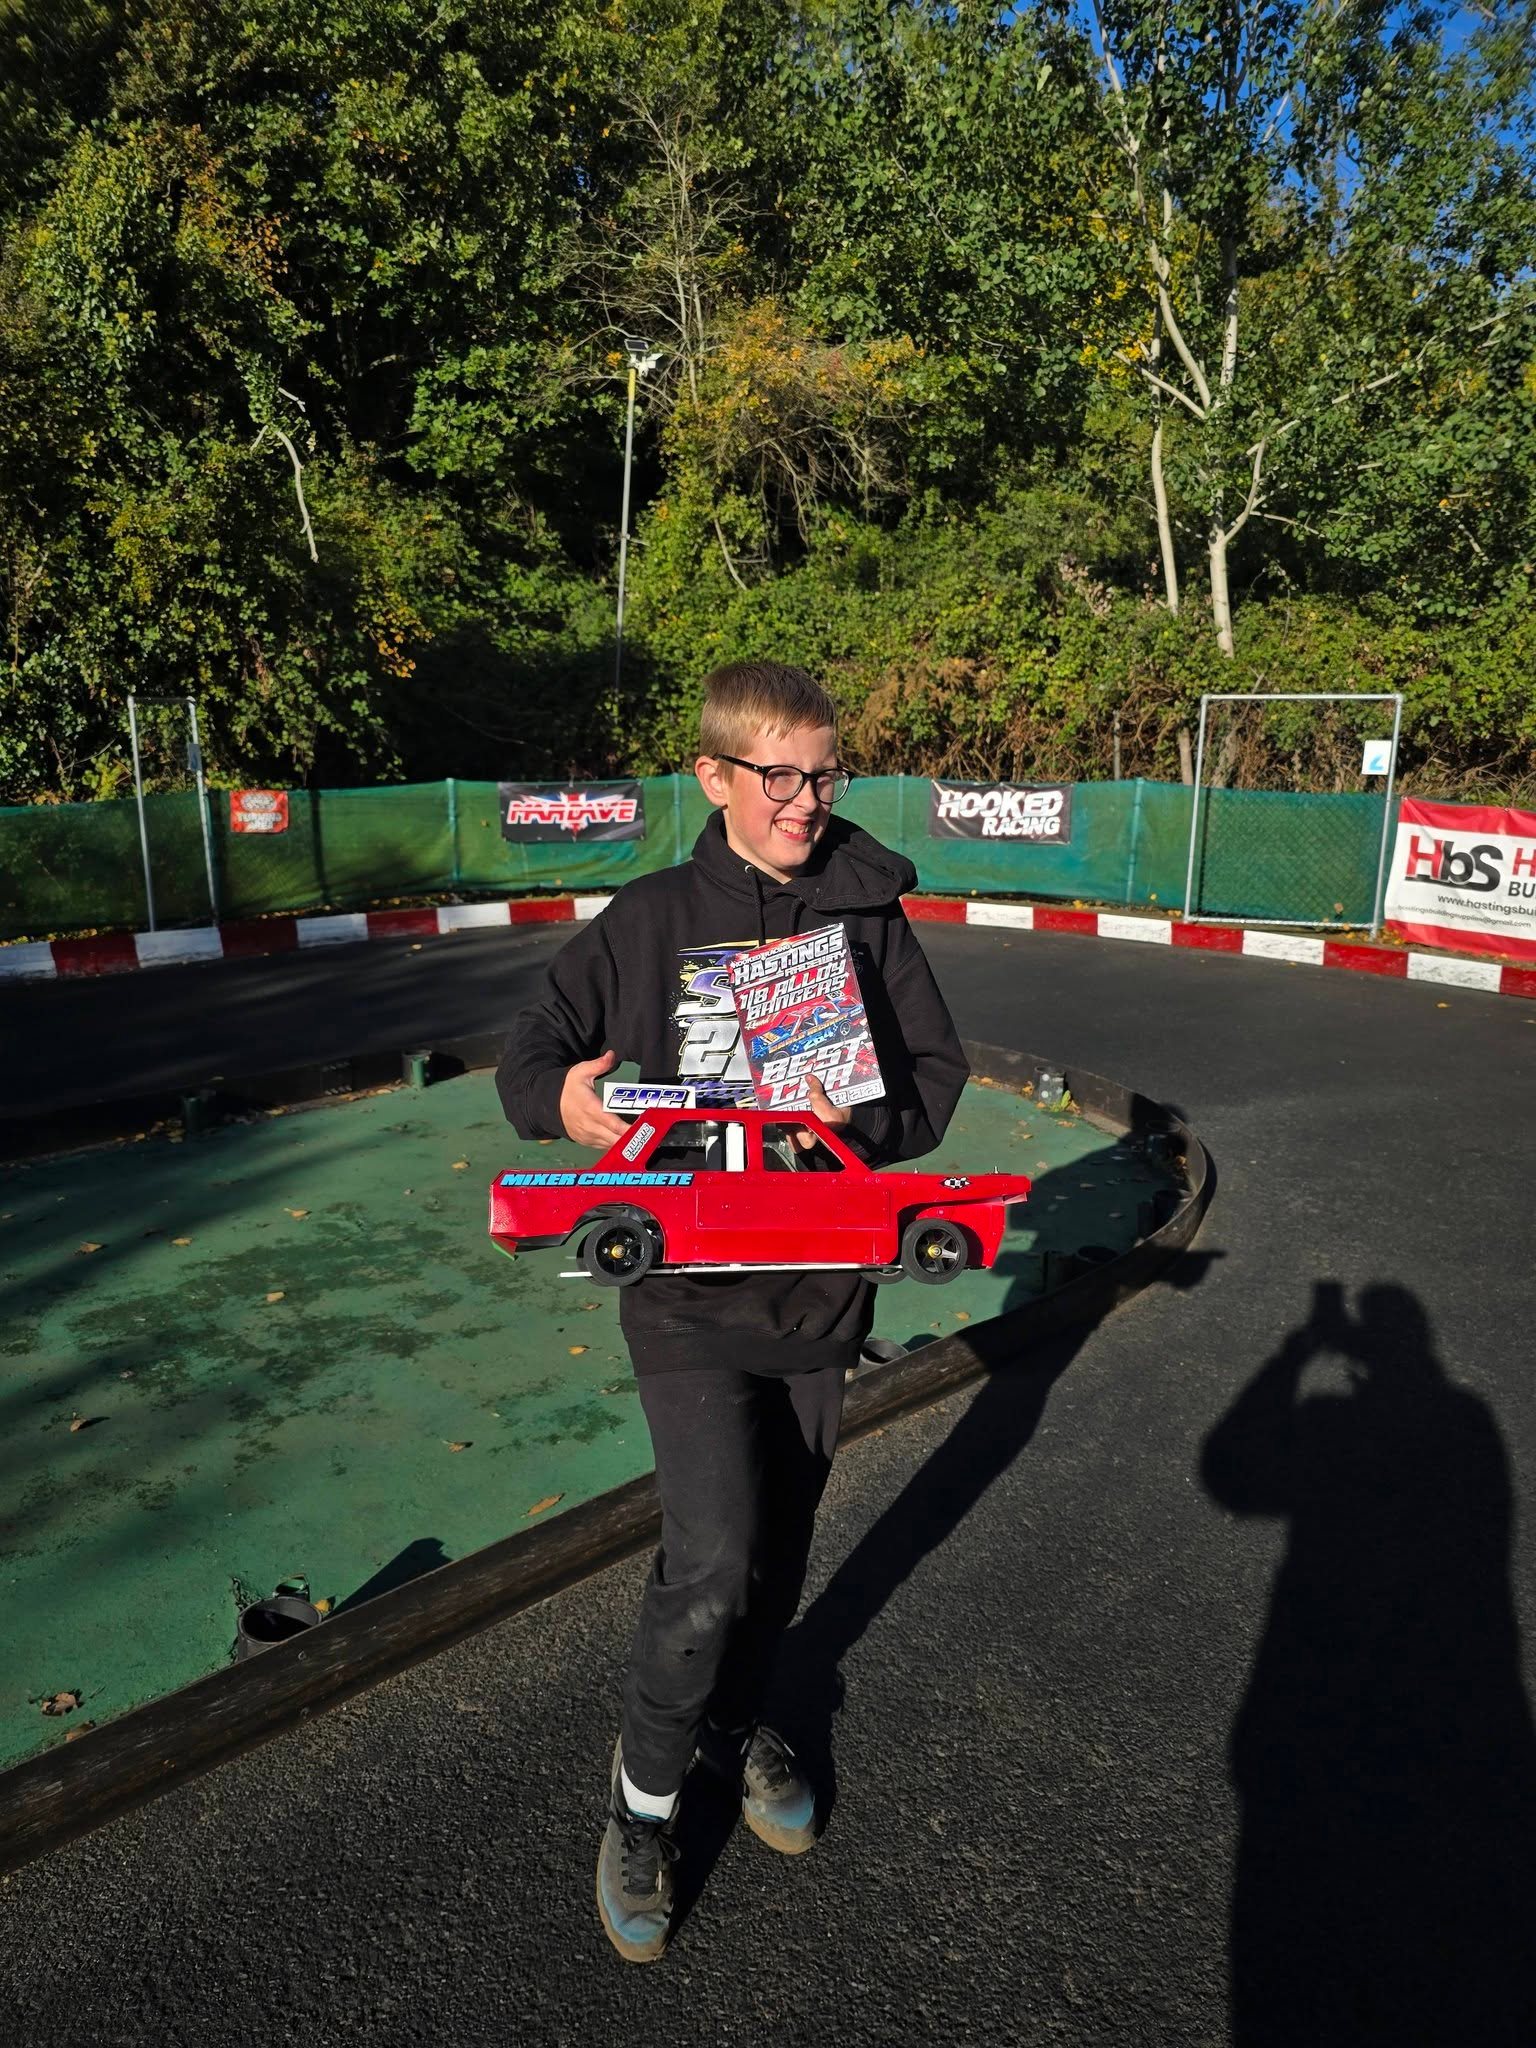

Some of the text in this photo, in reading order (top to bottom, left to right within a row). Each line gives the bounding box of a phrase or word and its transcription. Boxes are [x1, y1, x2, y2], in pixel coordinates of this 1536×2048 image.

[507, 799, 637, 824] MARDAVE
[937, 791, 1063, 818] HOOKED
[982, 817, 1061, 836] RACING
[1406, 835, 1504, 892] HbS
[733, 931, 843, 987] HASTINGS
[784, 949, 847, 978] RACEWAY
[774, 959, 847, 998] ALLOY
[746, 974, 849, 1022] BANGERS
[760, 1037, 864, 1087] BEST
[501, 1172, 694, 1186] MIXER CONCRETE
